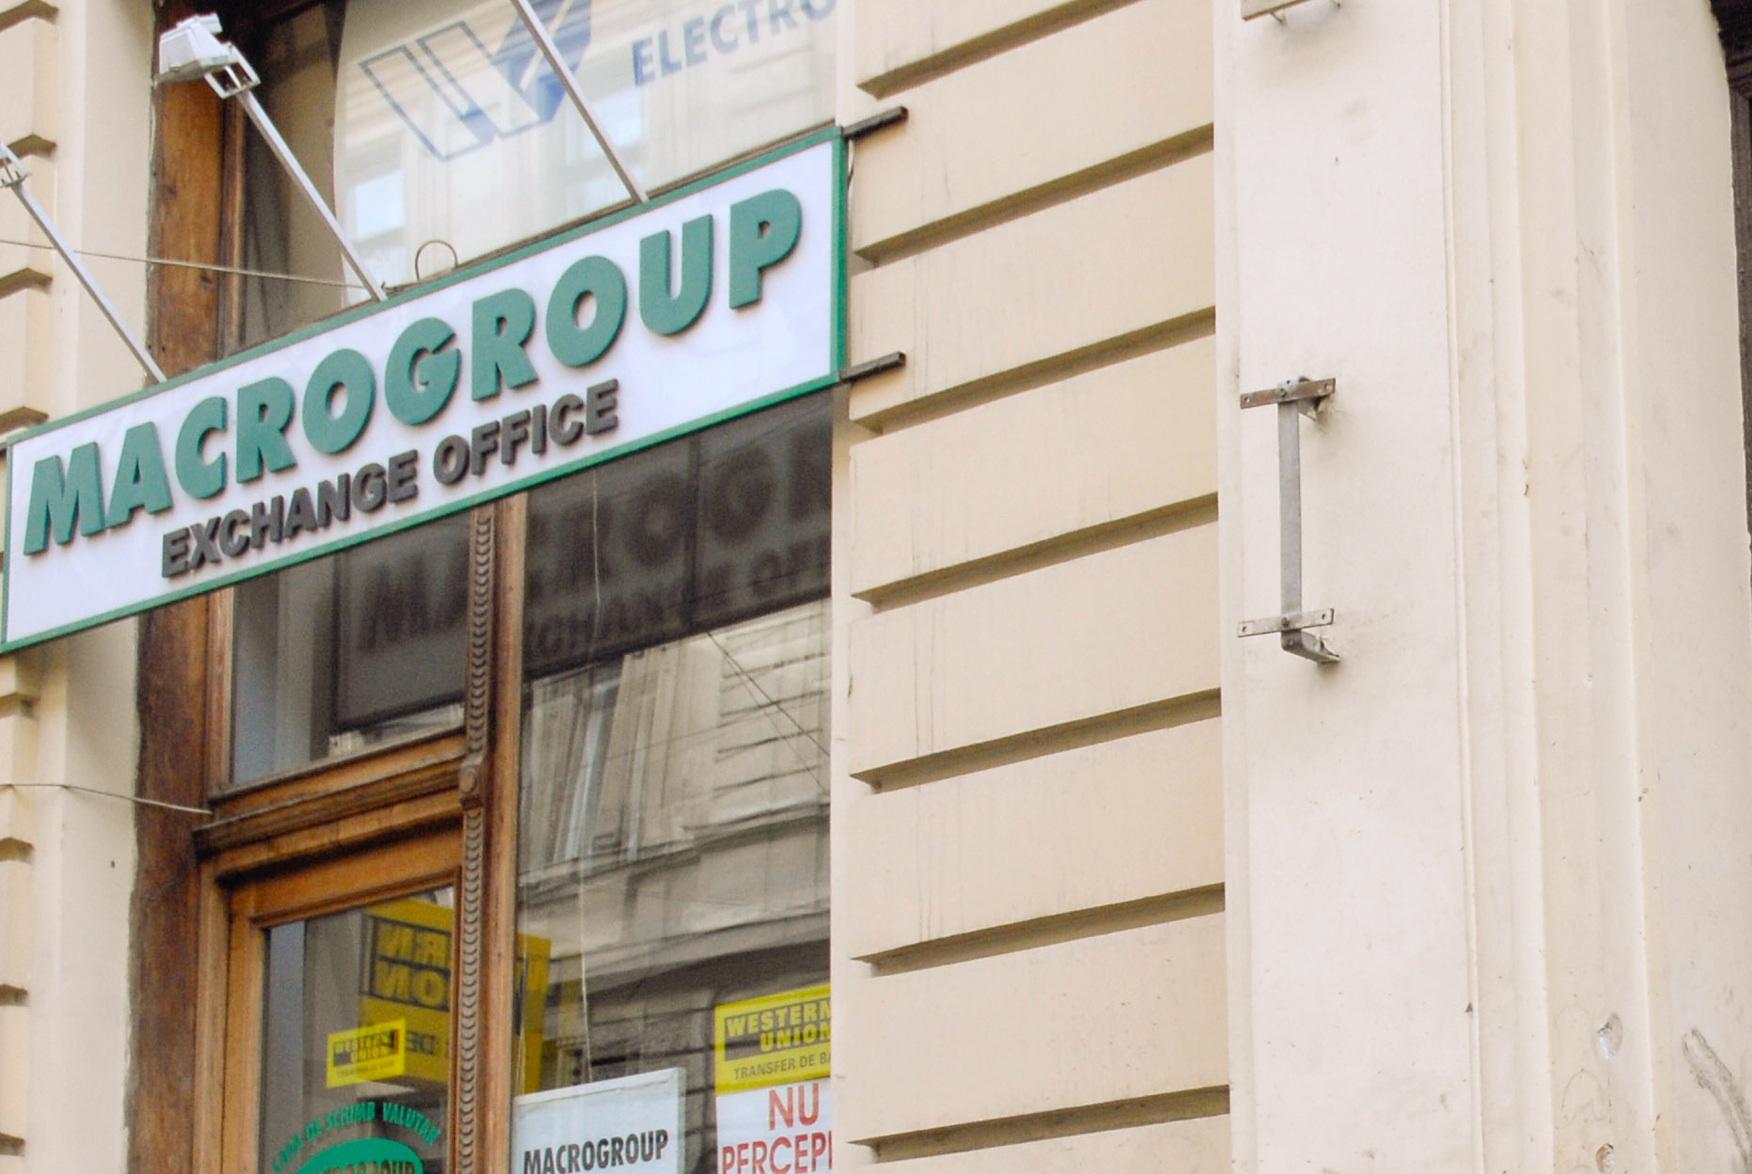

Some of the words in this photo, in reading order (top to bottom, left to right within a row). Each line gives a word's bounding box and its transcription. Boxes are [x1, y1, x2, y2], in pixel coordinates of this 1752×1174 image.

[23, 188, 803, 557] MACROGROUP
[161, 448, 419, 578] EXCHANGE
[432, 377, 619, 486] OFFICE
[727, 1001, 831, 1038] WESTERN
[760, 1021, 831, 1052] UNION
[733, 1058, 796, 1081] TRANSFER
[799, 1054, 815, 1068] DE
[768, 1083, 820, 1131] NU
